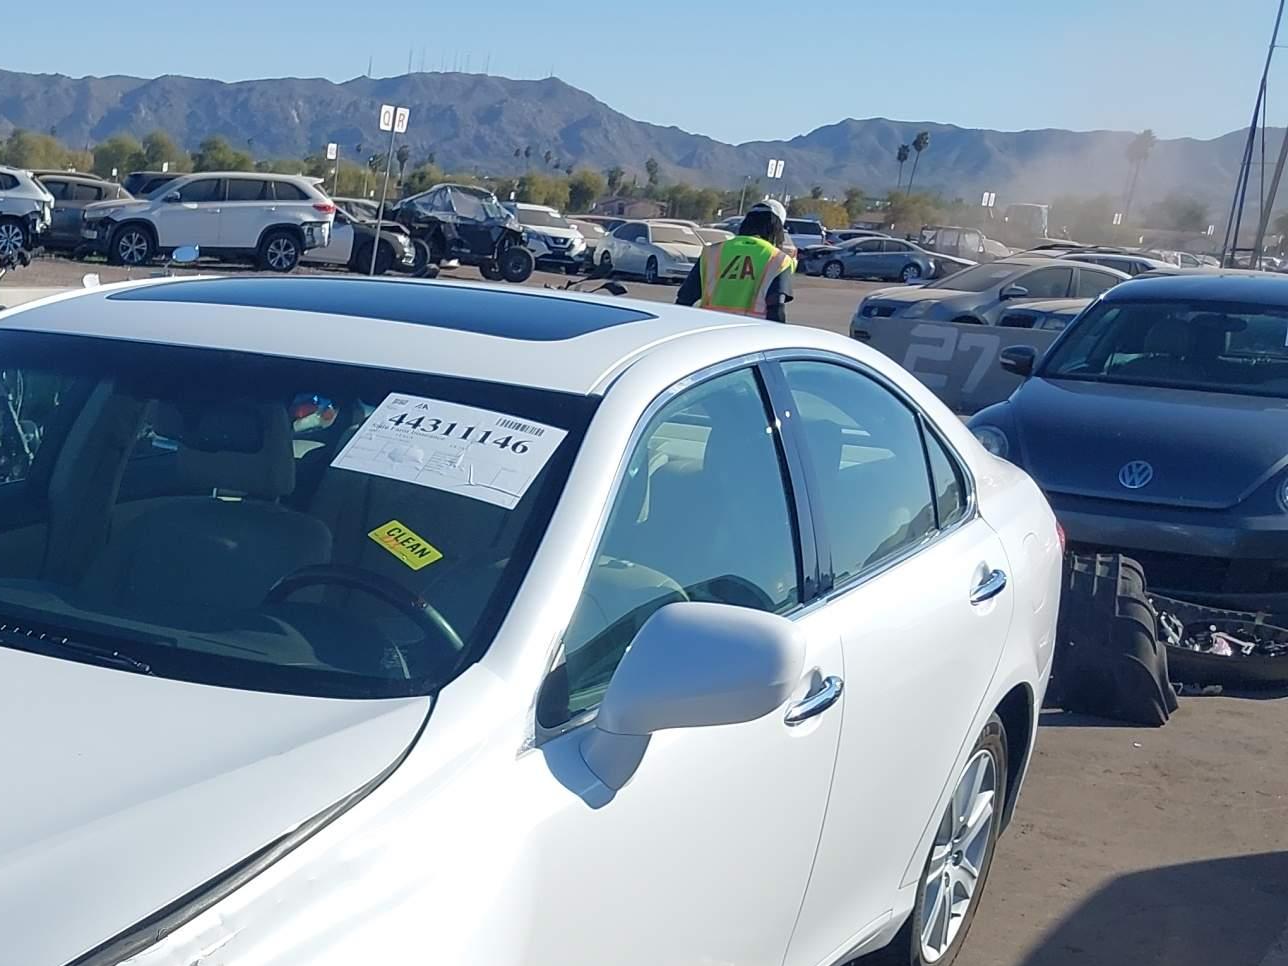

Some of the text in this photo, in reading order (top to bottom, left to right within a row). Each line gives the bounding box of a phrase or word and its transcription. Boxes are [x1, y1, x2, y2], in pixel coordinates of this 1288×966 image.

[383, 110, 391, 126] Q
[397, 112, 406, 129] R
[903, 323, 1000, 393] 27
[388, 413, 533, 454] 44311146
[386, 527, 431, 559] CLEAN
